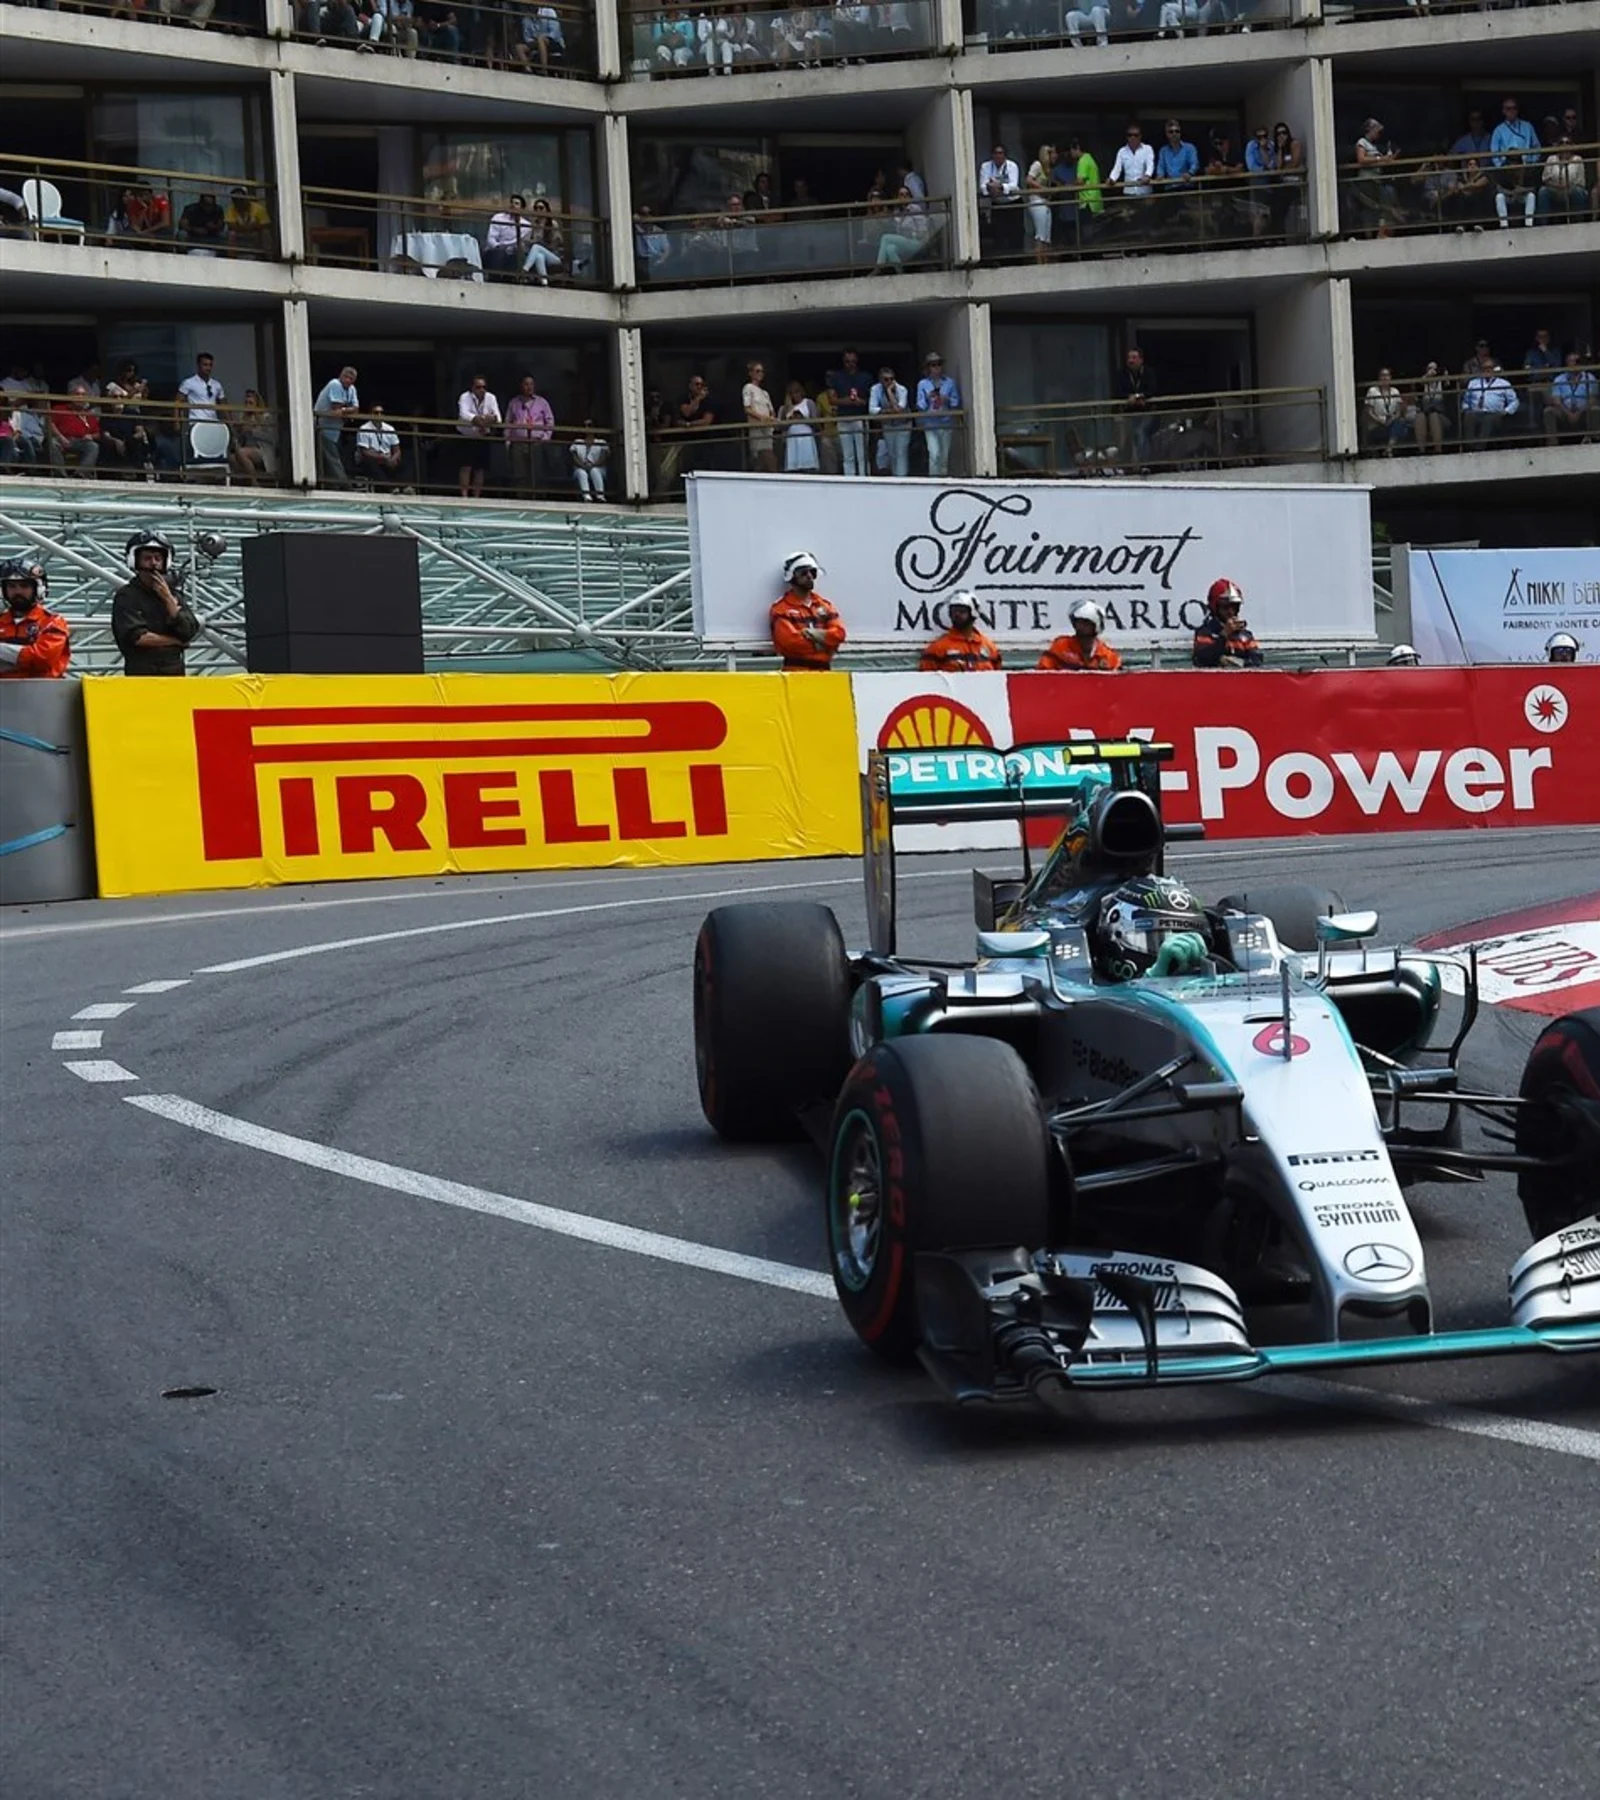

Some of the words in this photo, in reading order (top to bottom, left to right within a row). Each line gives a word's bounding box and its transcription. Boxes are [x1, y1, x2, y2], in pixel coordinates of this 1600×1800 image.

[894, 489, 1204, 594] Fairmont
[1526, 581, 1566, 606] NIKKI
[1102, 598, 1211, 631] ARLO
[1503, 620, 1554, 630] FAIRMONT
[192, 700, 728, 861] PIRELLI
[888, 748, 1112, 784] PETRONA
[1251, 1021, 1312, 1058] 6
[1287, 1149, 1380, 1167] PIRELLI
[1313, 1200, 1395, 1212] PETRONAS
[1317, 1208, 1401, 1228] SYNTIUM
